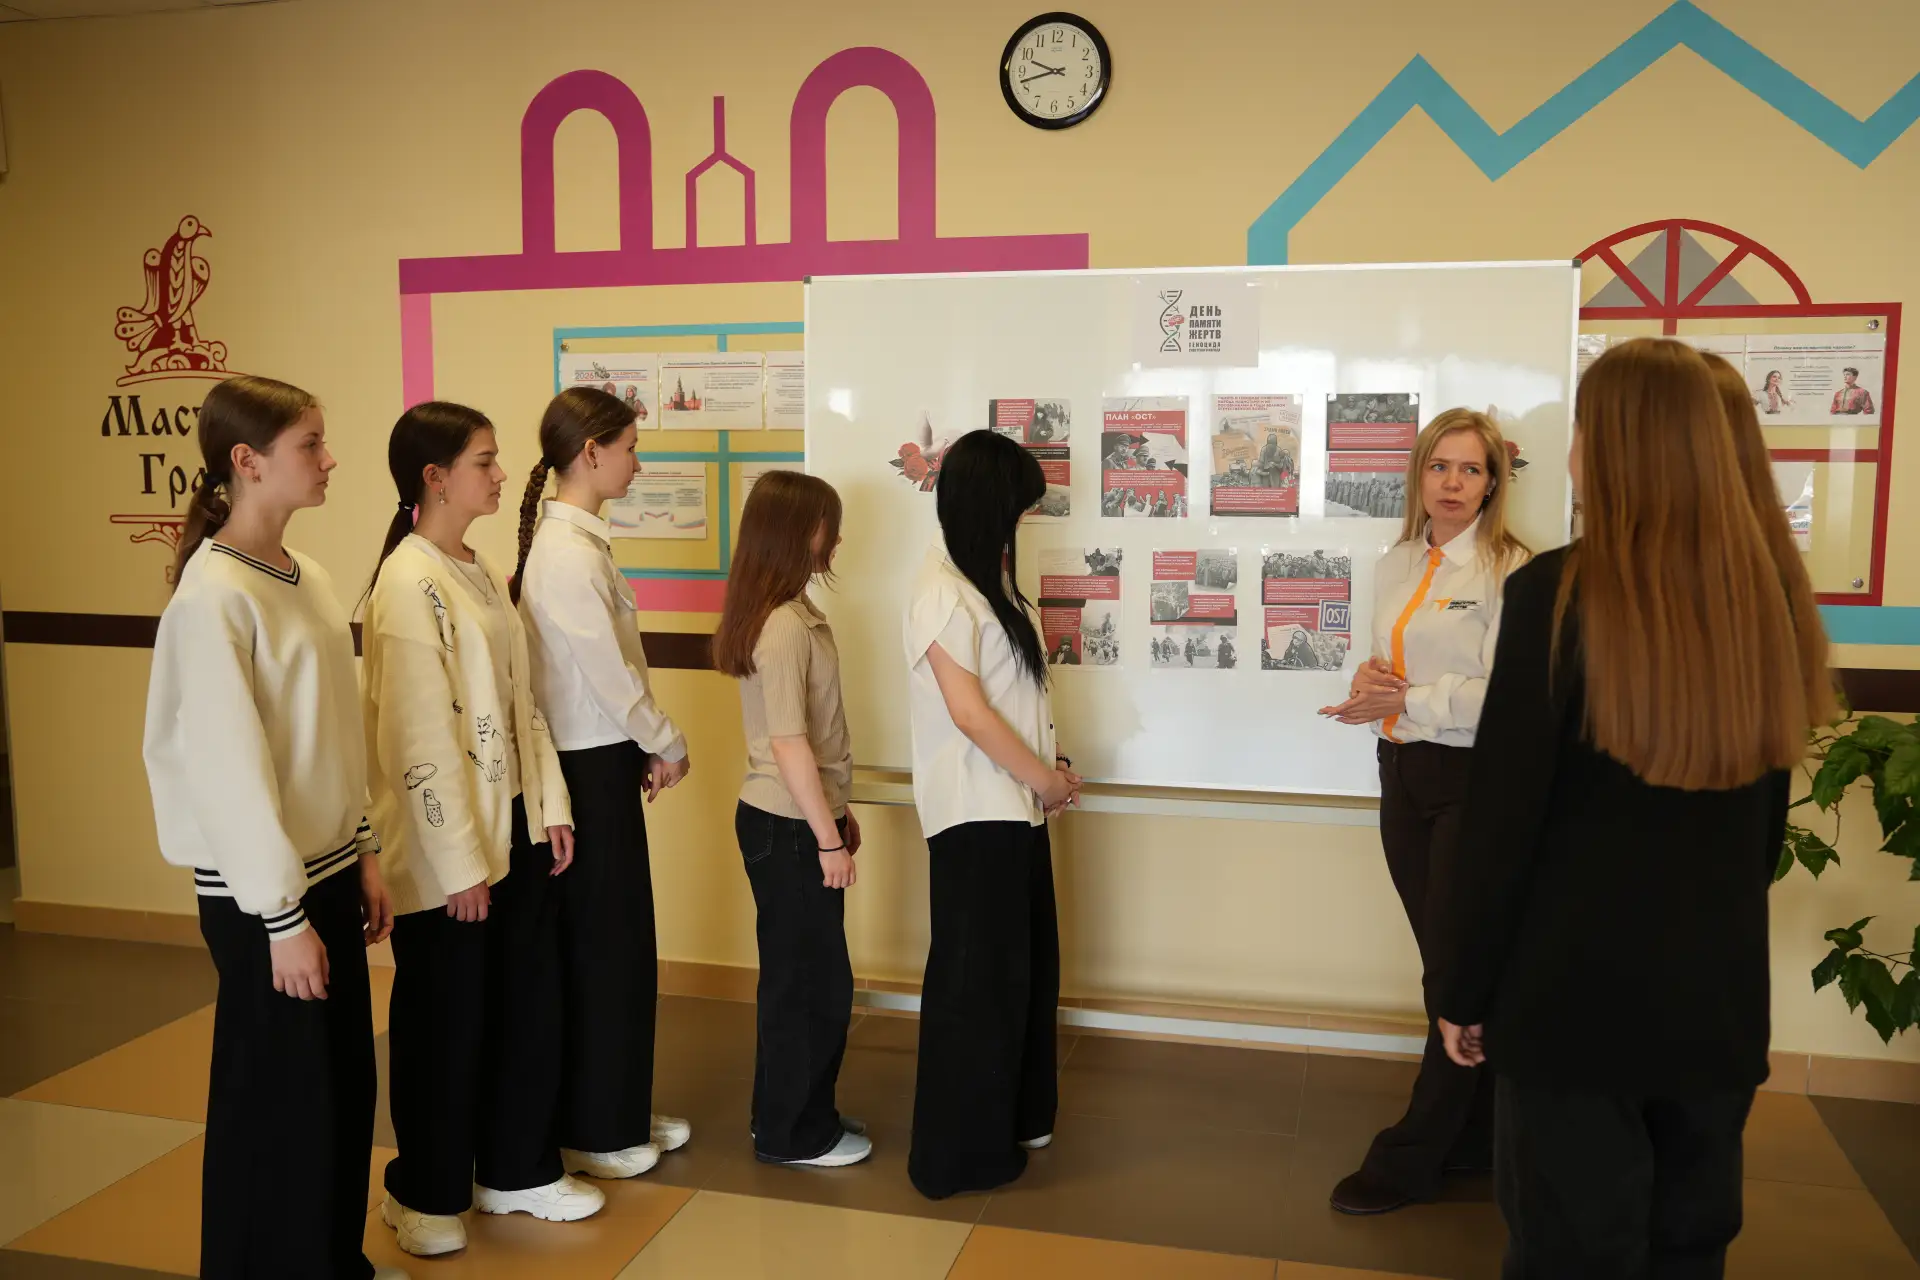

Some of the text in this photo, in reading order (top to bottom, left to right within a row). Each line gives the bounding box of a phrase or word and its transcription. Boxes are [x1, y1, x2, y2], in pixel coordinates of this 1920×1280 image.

[1036, 34, 1045, 48] 11
[1051, 30, 1064, 43] 12
[1072, 34, 1076, 48] 1
[1021, 47, 1034, 60] 10
[1082, 48, 1090, 61] 2
[1018, 65, 1026, 78] 9
[1085, 65, 1093, 78] 3
[1023, 83, 1030, 95] 8
[1079, 83, 1087, 96] 4
[1034, 95, 1041, 108] 7
[1050, 100, 1058, 113] 6
[1067, 96, 1075, 109] 5
[1190, 305, 1221, 318] ДЕНЬ
[1189, 319, 1221, 328] ПАМЯТИ
[1189, 329, 1221, 340] ЖЕРТВ
[1105, 413, 1157, 421] ПЛАН «ОСТ»
[1326, 607, 1348, 625] OST
